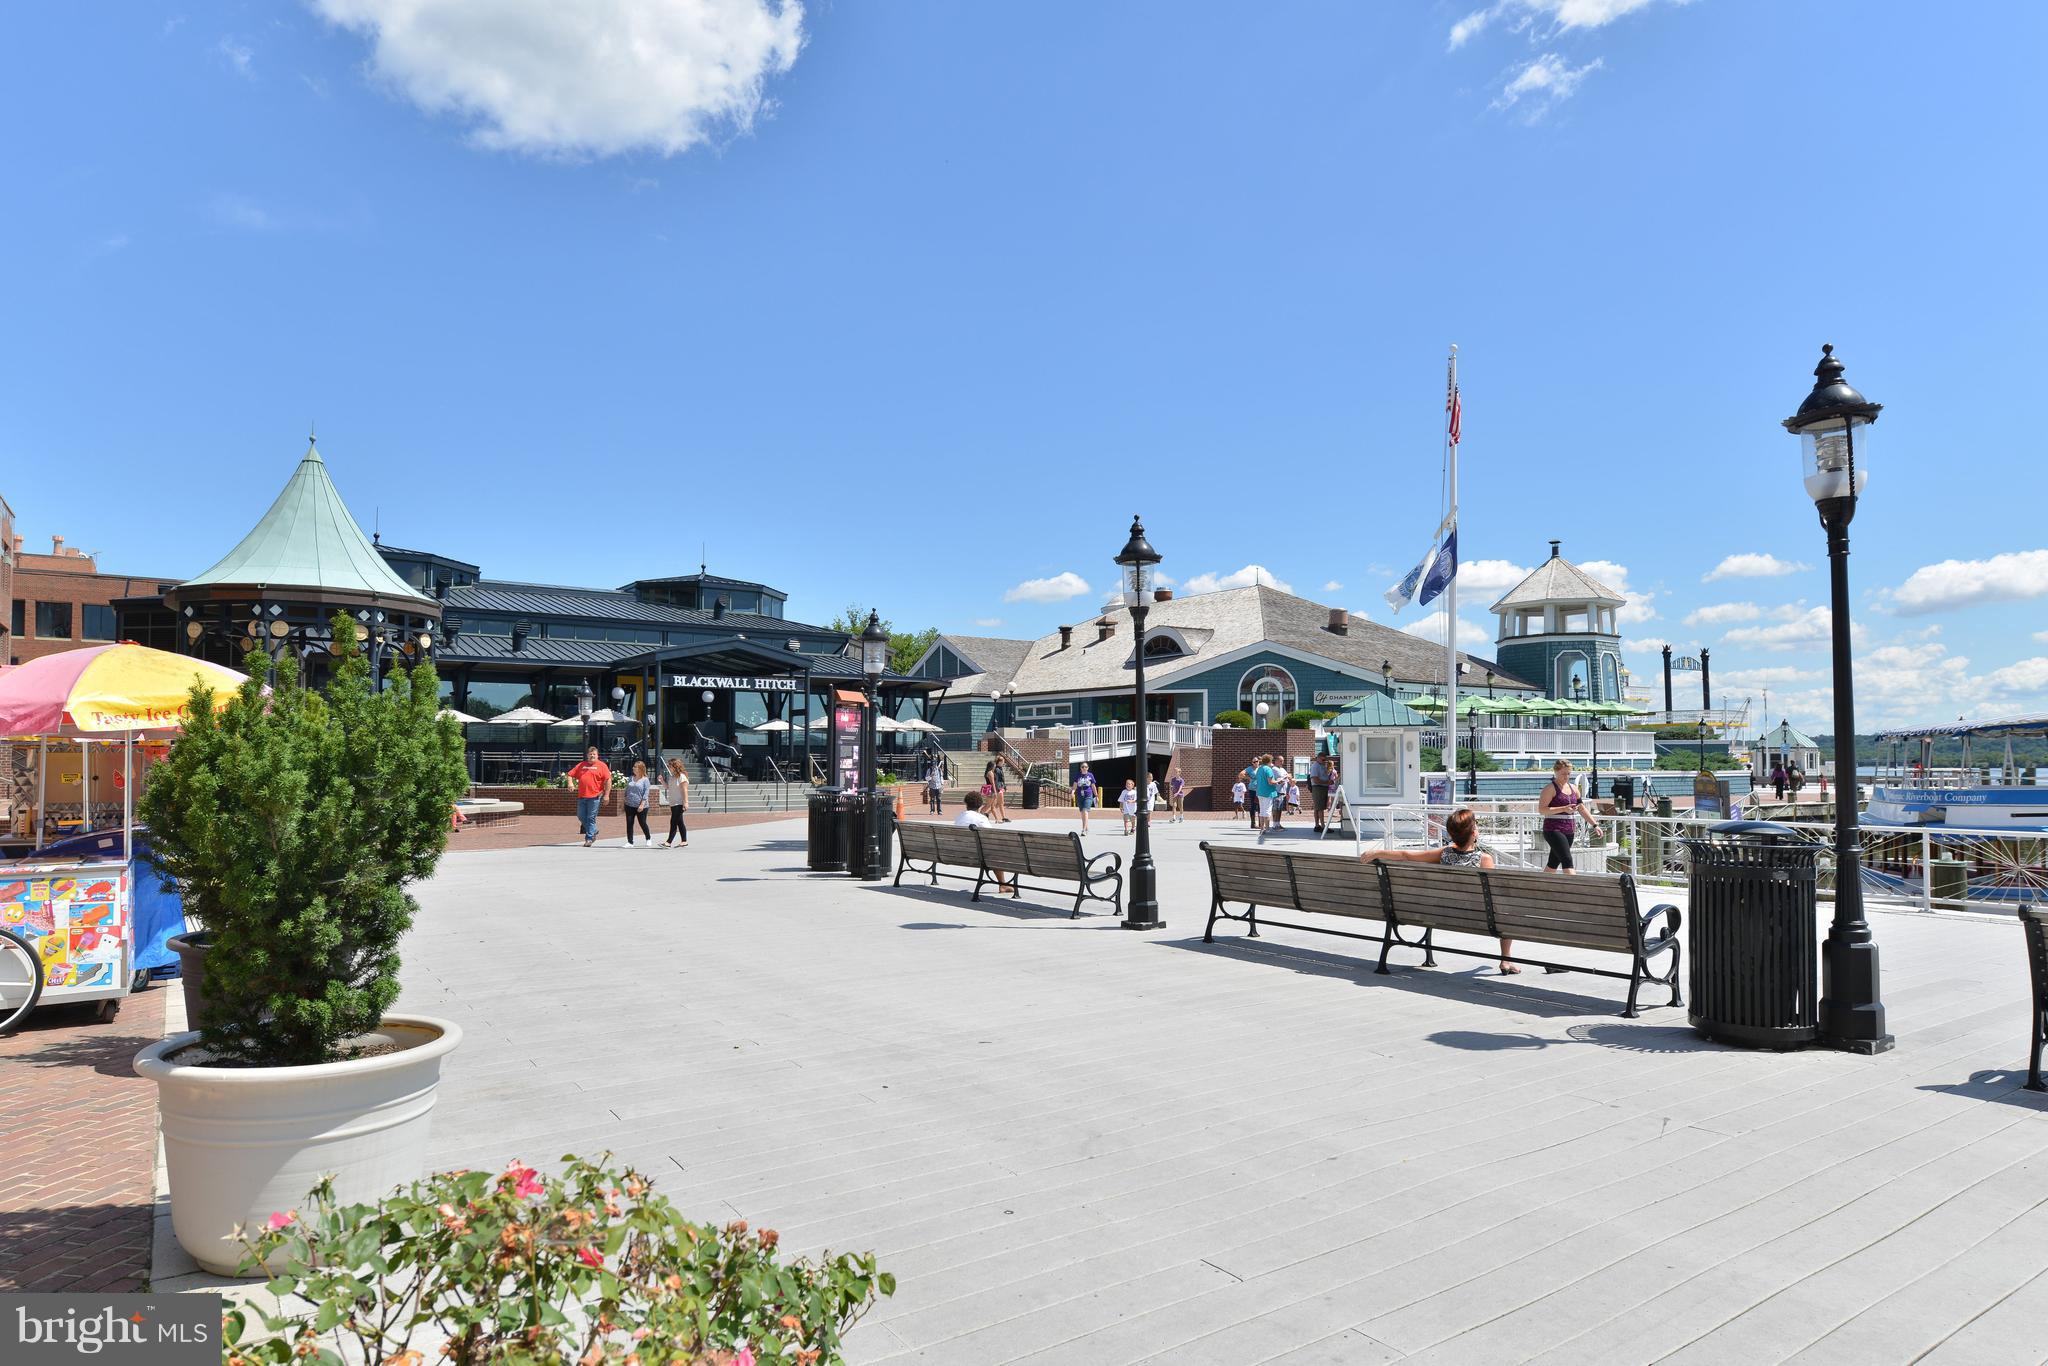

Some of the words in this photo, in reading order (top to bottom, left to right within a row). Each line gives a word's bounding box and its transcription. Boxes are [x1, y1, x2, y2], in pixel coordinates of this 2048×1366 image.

[673, 675, 750, 688] BLACKWALL
[755, 678, 796, 690] HITCH
[91, 711, 140, 726] Tasty
[145, 707, 171, 721] Ice
[1944, 792, 1987, 804] Company
